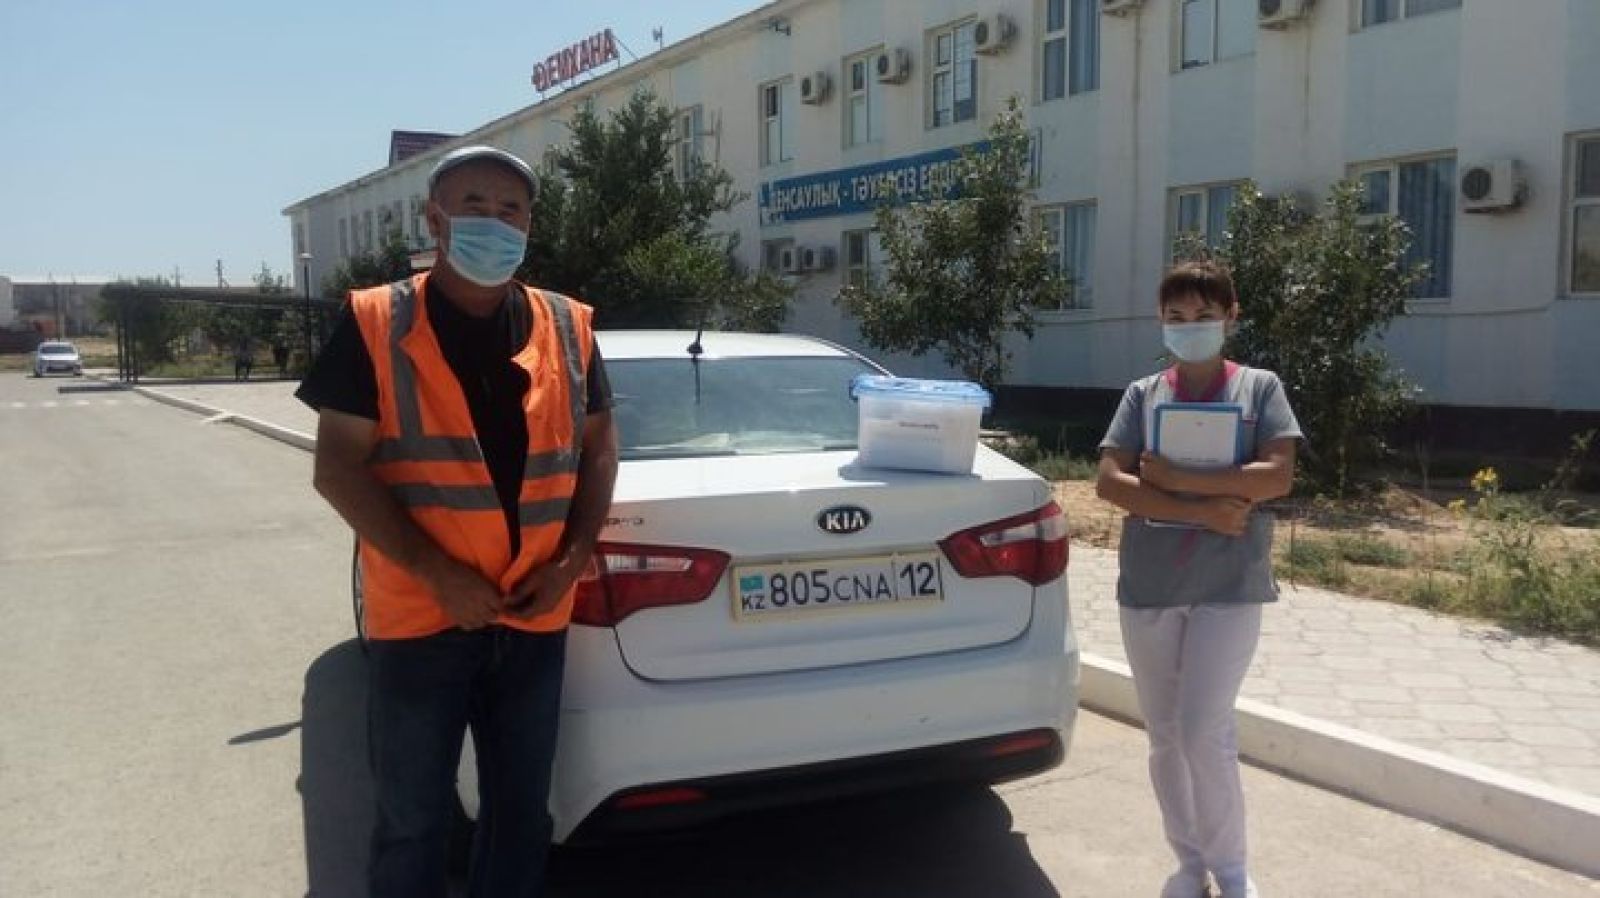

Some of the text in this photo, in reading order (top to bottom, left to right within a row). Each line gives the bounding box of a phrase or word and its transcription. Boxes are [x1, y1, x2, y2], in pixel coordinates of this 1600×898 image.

[825, 509, 866, 531] KIA
[741, 595, 766, 610] KZ
[899, 561, 937, 597] 12
